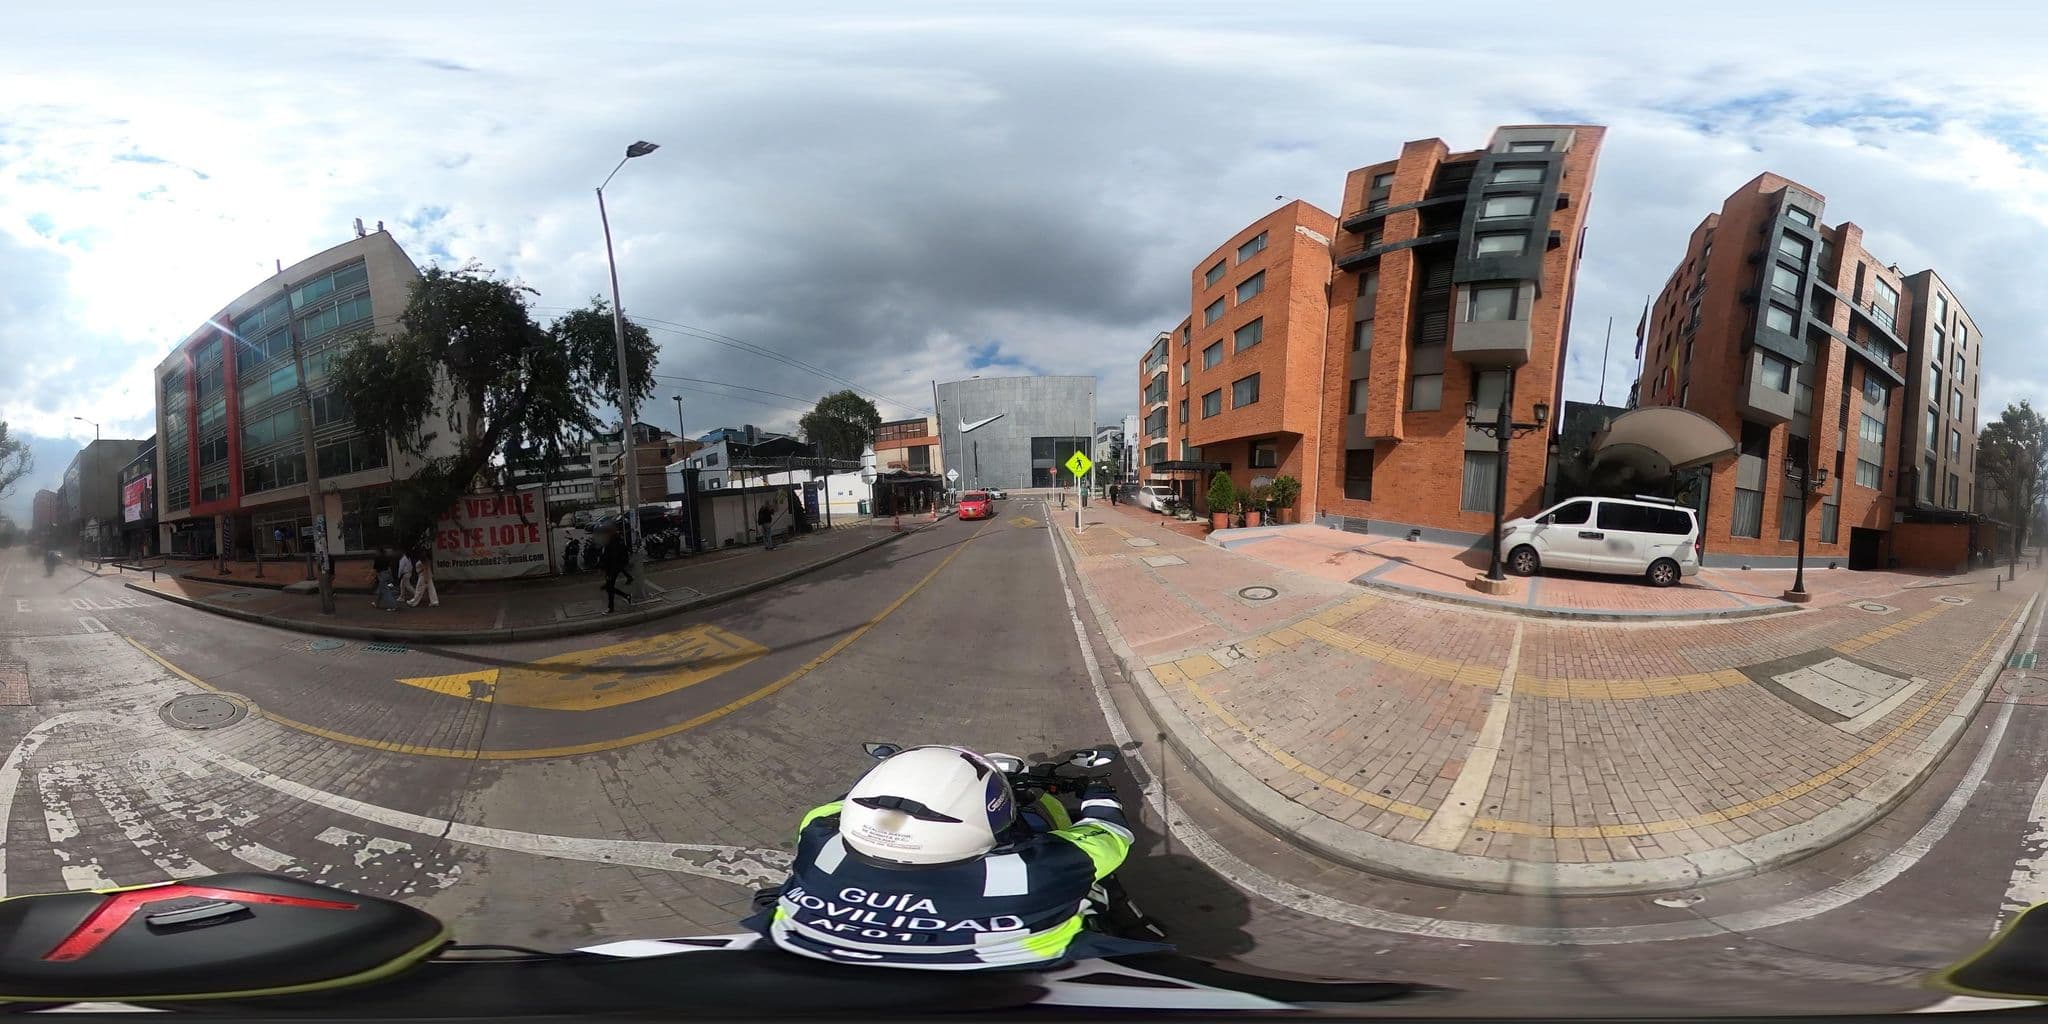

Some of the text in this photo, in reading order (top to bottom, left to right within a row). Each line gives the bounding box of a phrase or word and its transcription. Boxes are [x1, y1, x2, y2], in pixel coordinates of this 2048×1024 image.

[465, 494, 535, 518] VENDE
[437, 523, 541, 550] ESTE LOTE
[786, 886, 1026, 932] MOVILIDAD
[838, 887, 938, 914] GUÍA
[810, 918, 914, 942] AF01
